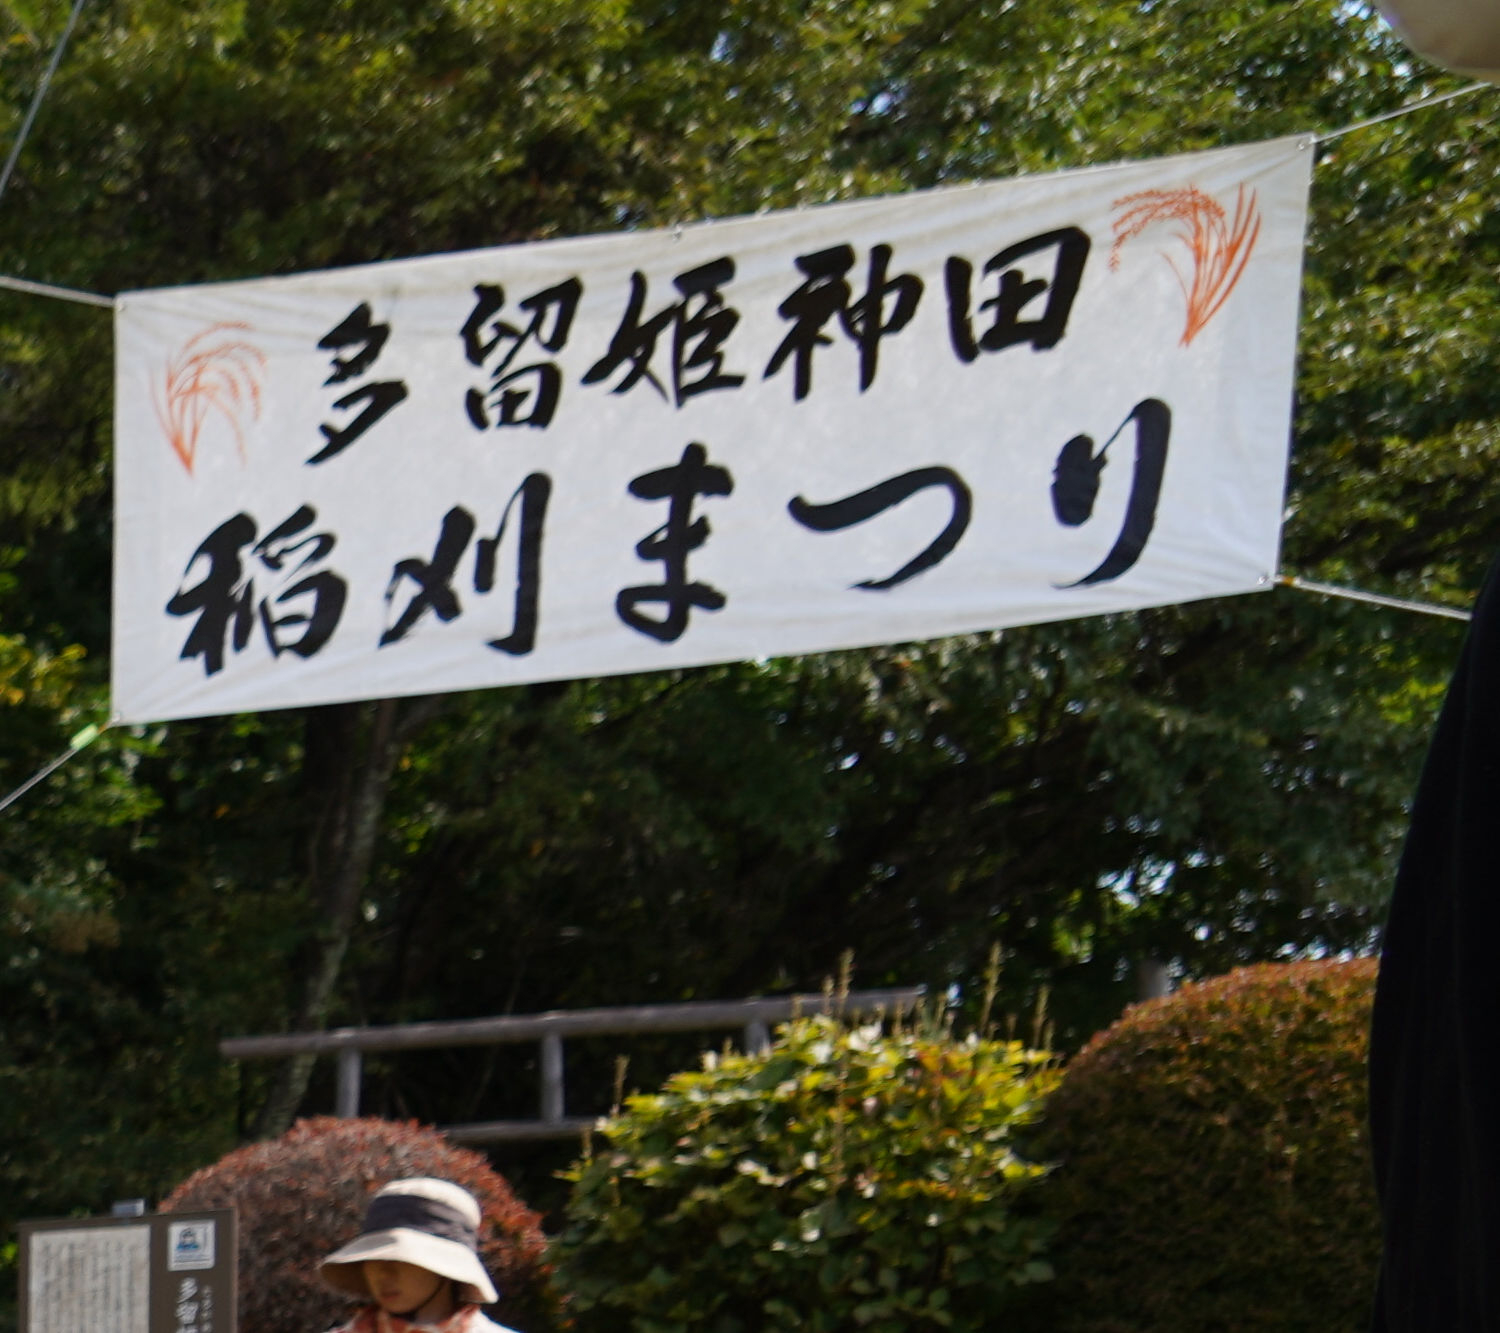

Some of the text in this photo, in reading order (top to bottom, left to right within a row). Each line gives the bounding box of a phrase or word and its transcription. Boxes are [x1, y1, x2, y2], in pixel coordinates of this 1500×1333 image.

[306, 225, 1093, 466] 多留姫神田
[165, 397, 1172, 677] 稲刈まつり
